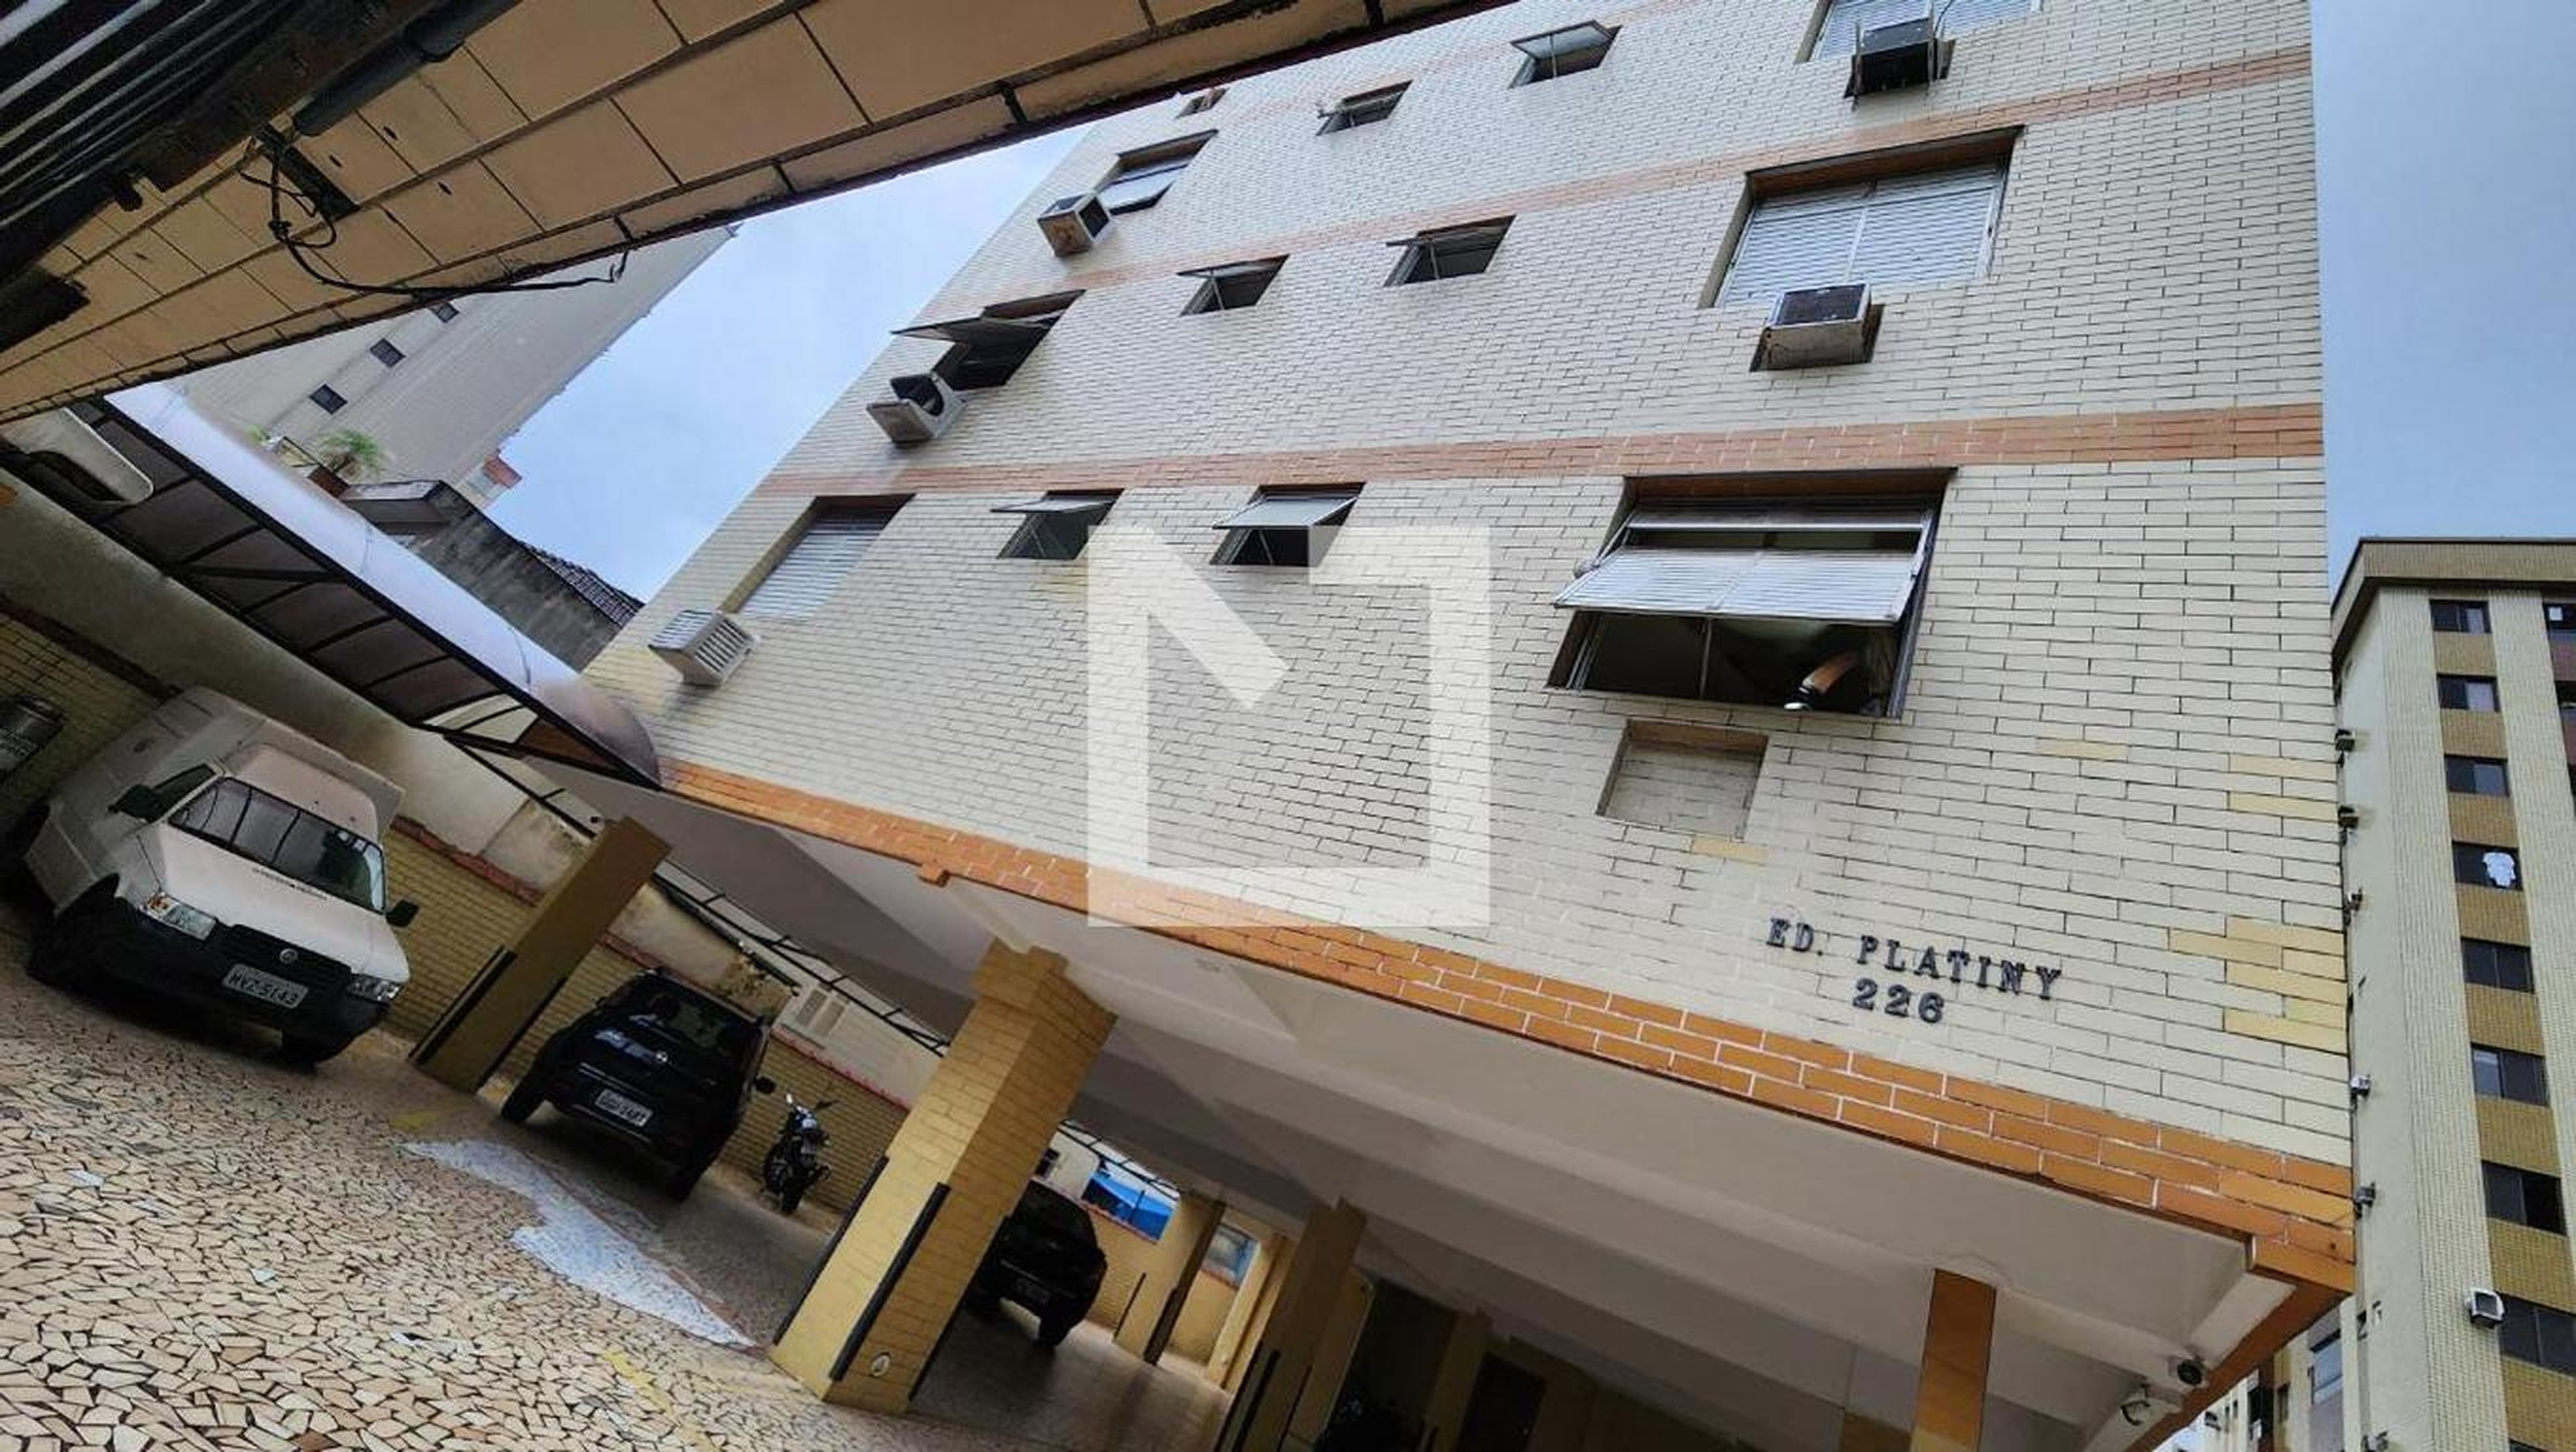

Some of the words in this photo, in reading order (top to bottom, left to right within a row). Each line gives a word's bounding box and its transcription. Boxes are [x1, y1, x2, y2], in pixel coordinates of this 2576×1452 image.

[1766, 917, 1824, 957] ED.
[1857, 935, 2061, 1000] PLATINY
[1851, 977, 1945, 1024] 226
